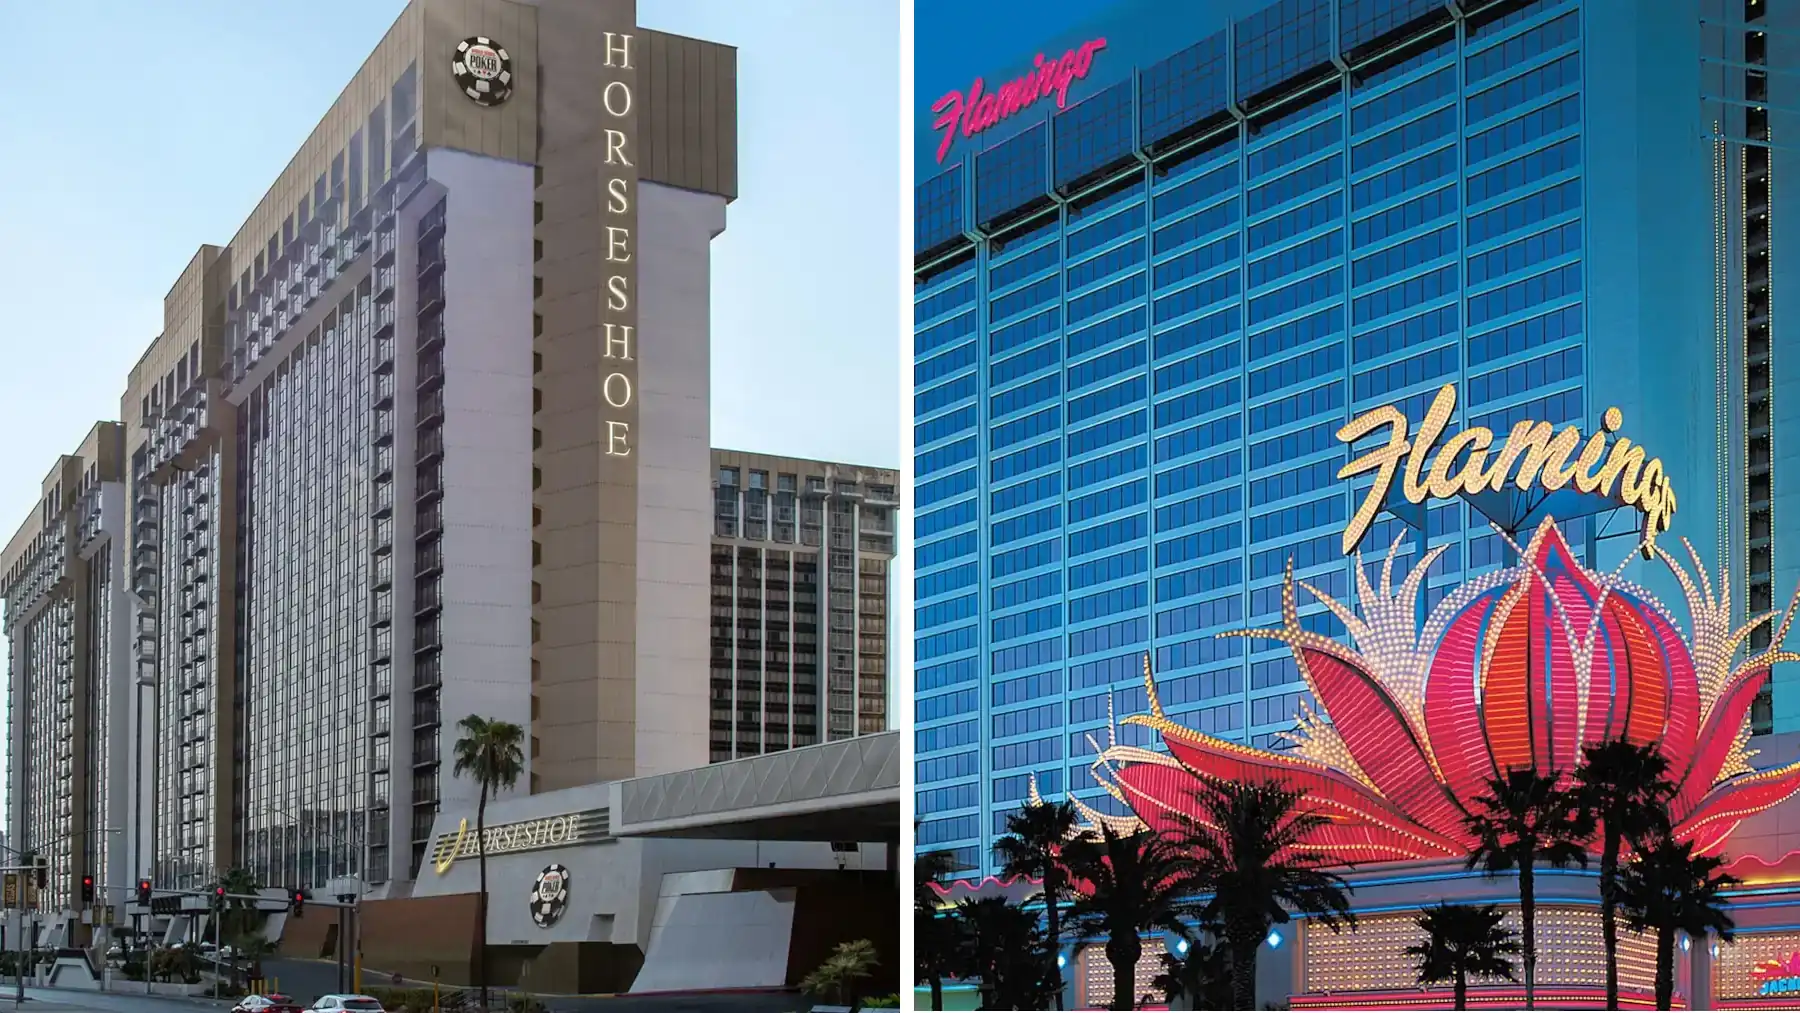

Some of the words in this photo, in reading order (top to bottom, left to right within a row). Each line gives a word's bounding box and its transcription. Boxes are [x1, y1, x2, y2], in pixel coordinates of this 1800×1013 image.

[470, 54, 497, 72] POKER
[931, 37, 1107, 165] Flamingo
[603, 31, 634, 457] HORSESHOE
[1335, 383, 1677, 560] Flamingo
[462, 814, 581, 855] HORSESHOE
